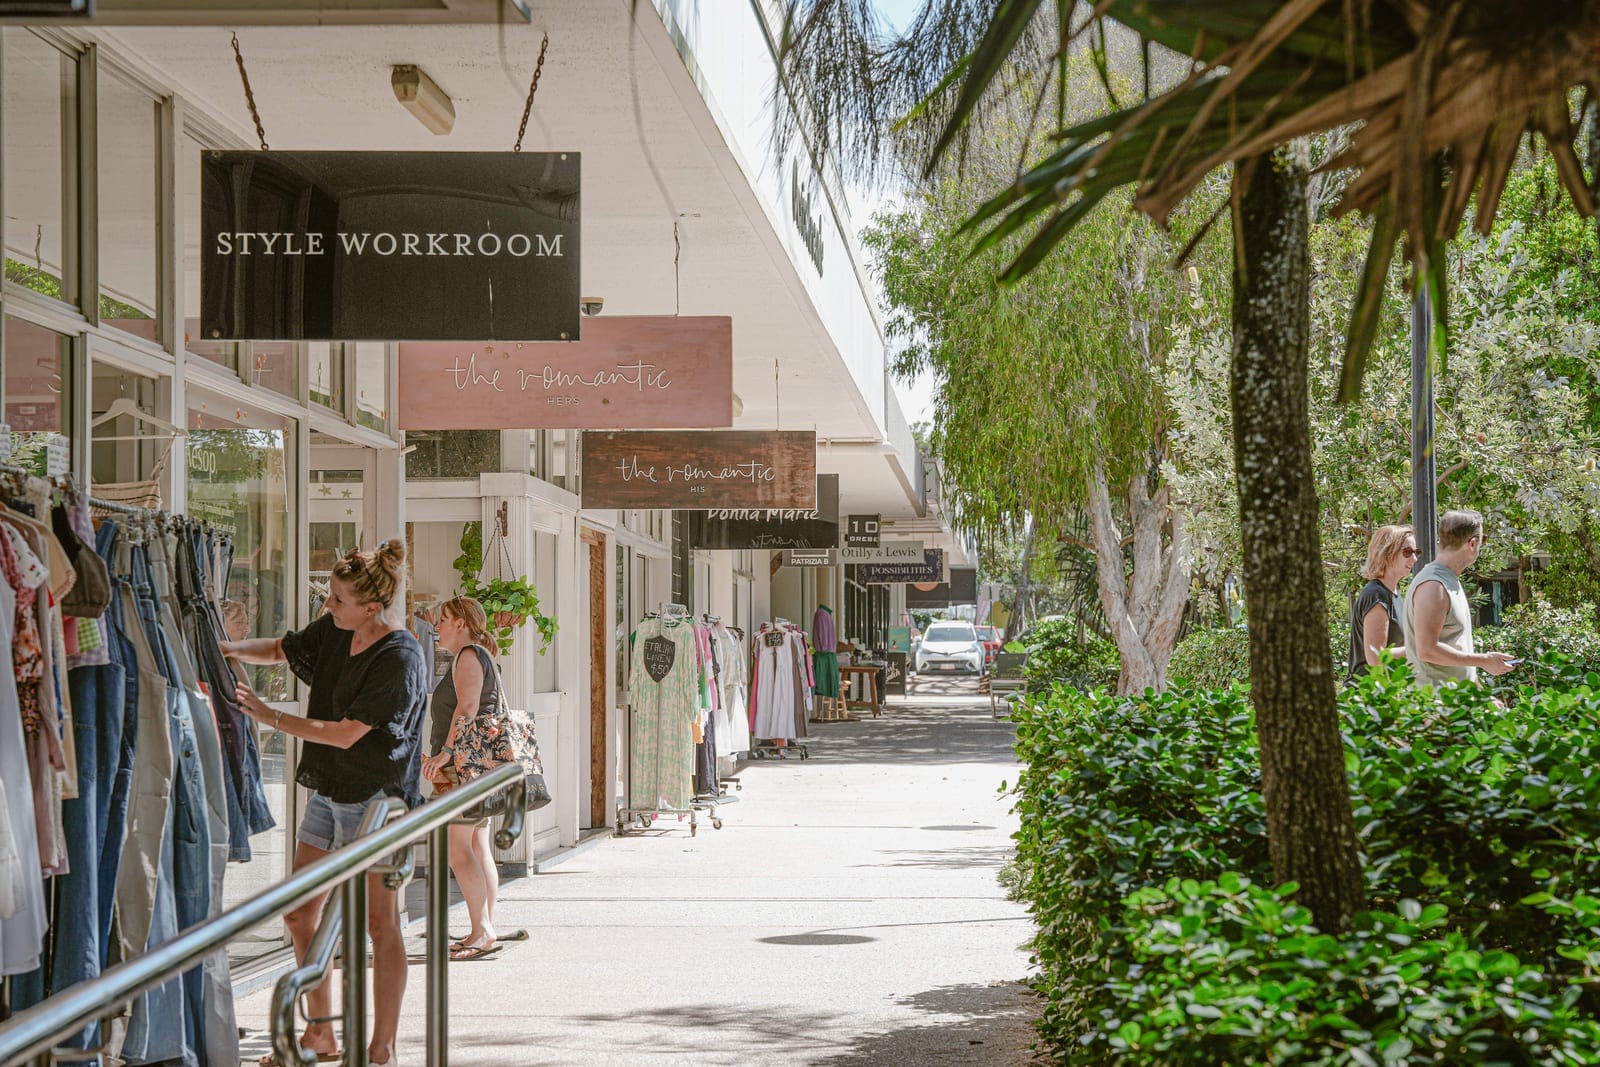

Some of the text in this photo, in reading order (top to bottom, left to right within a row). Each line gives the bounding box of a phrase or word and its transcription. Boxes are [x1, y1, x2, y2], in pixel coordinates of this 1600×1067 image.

[216, 231, 564, 257] STYLE WORKROOM
[444, 352, 672, 392] the romantic
[547, 396, 581, 406] HERS
[615, 455, 776, 483] the romantic
[707, 509, 820, 526] Donna Marie
[852, 520, 879, 534] 10
[841, 546, 917, 560] Otilly & Lewis
[791, 558, 822, 566] PATRIZIA
[871, 566, 933, 576] POSSIBILITIES
[646, 654, 672, 664] LINEN
[650, 662, 670, 675] $50
